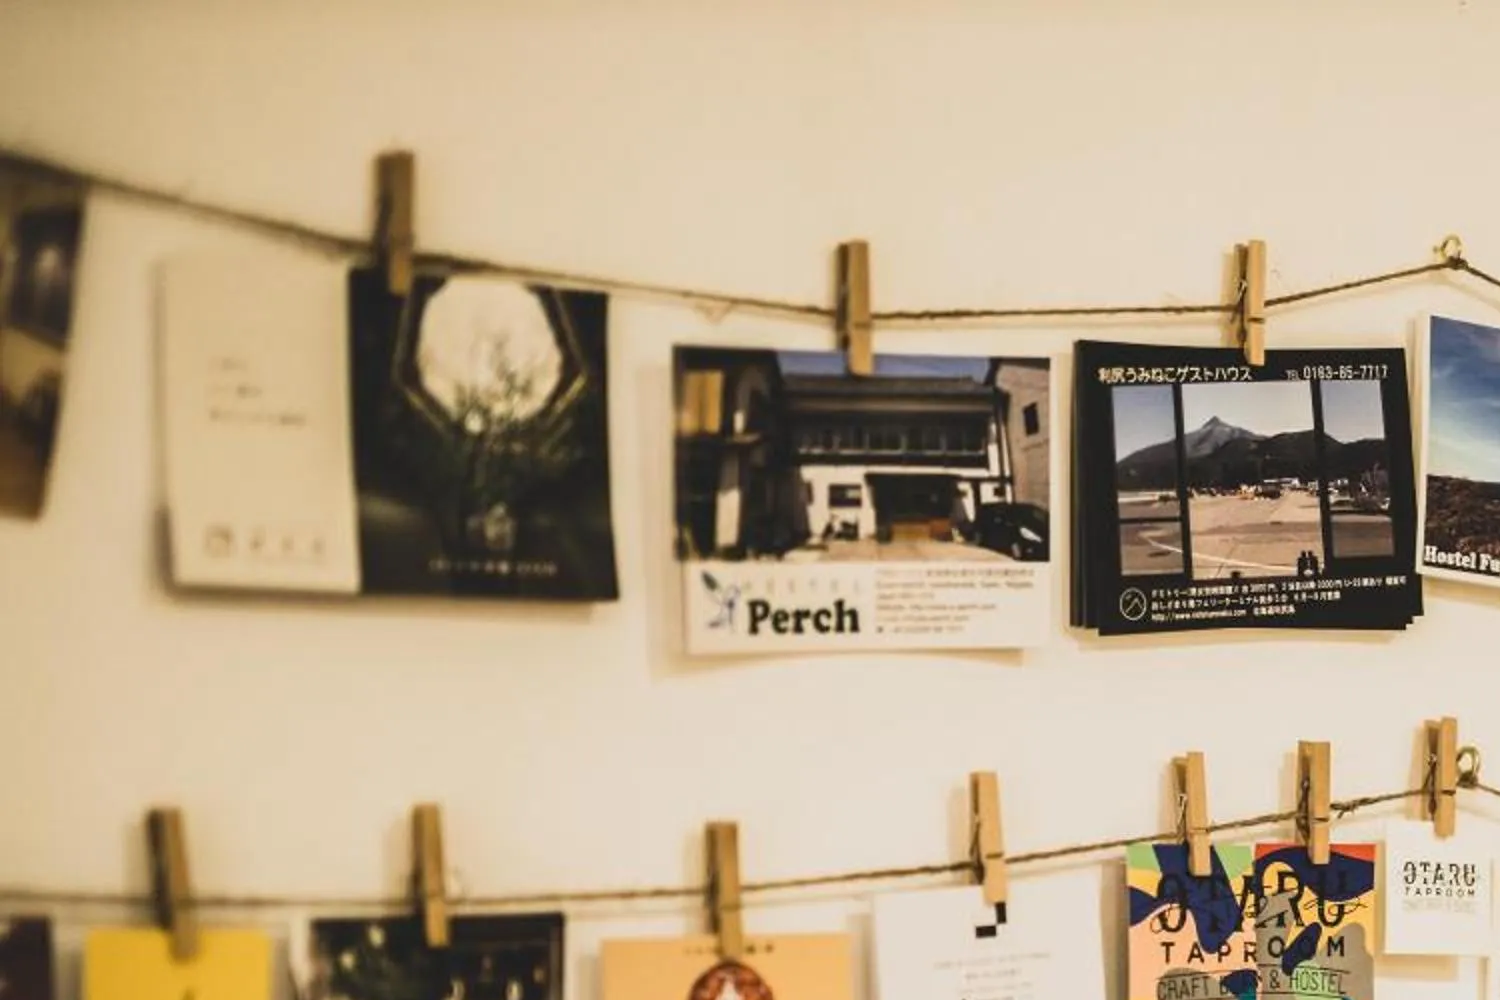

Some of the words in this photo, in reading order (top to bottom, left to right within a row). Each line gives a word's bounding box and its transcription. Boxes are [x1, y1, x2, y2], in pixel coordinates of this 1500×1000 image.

[1424, 546, 1476, 569] Hostel
[748, 598, 860, 635] Perch
[1404, 861, 1475, 887] OTARU
[1405, 886, 1475, 898] TAPROOM
[1160, 935, 1346, 964] TAPROM
[1157, 976, 1210, 1000] CRAFT
[1269, 969, 1281, 990] &
[1290, 969, 1346, 995] HOSTEL
